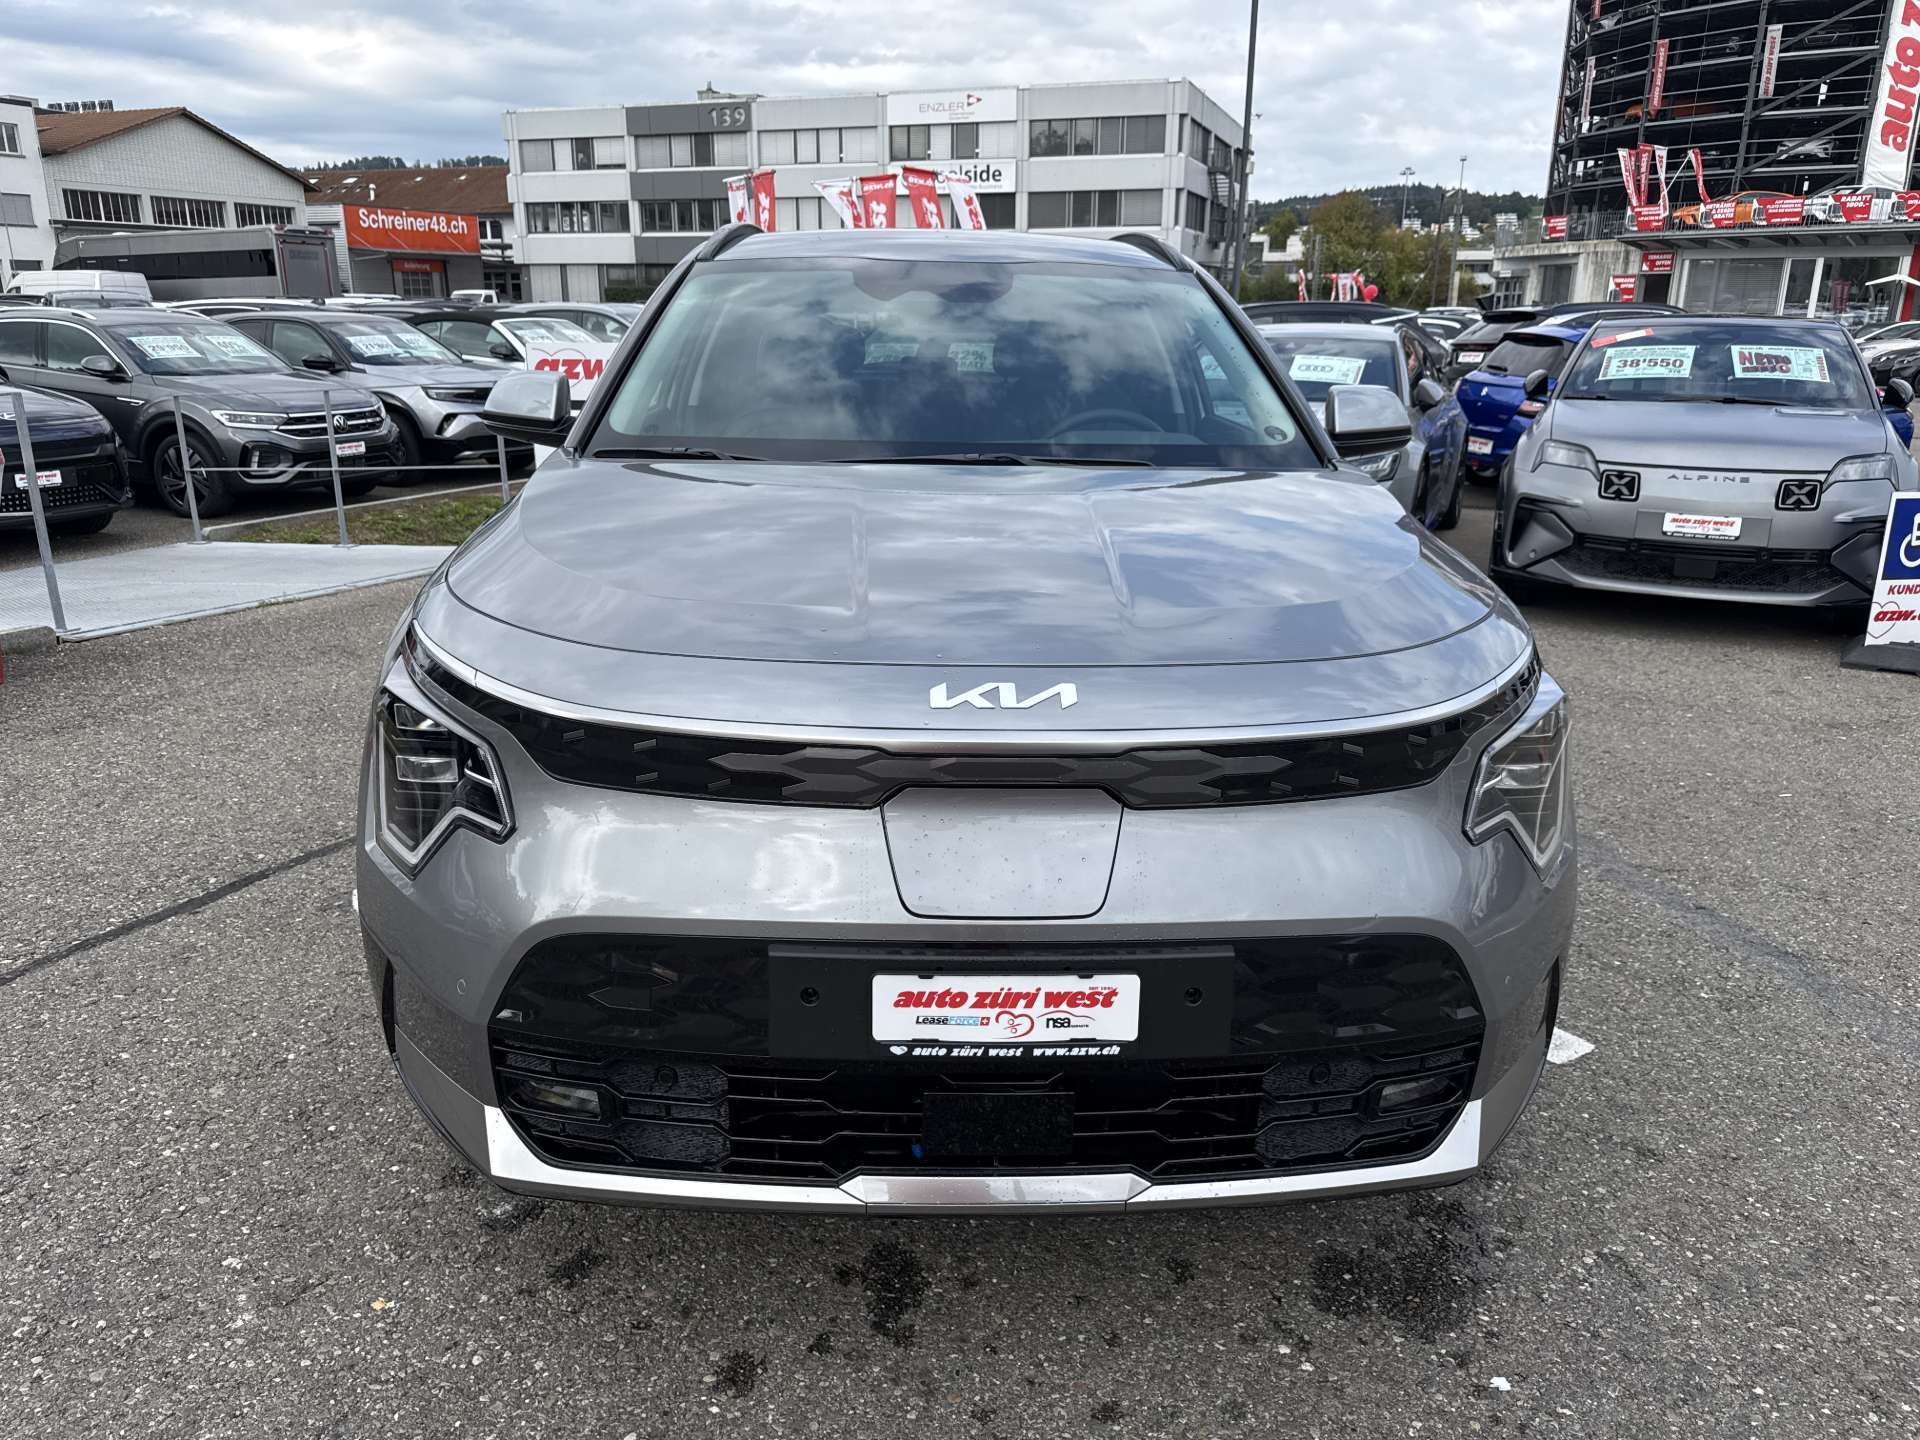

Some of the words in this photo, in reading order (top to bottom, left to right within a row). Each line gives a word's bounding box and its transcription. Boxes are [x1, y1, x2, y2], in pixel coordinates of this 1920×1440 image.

[919, 102, 965, 113] ENZLER
[709, 107, 746, 127] 139
[359, 208, 467, 234] Schreiner48.ch
[1615, 358, 1685, 369] 38'550
[1667, 473, 1750, 484] ALPINE
[1874, 609, 1920, 623] azw.
[893, 987, 969, 1009] auto
[969, 986, 1042, 1009] züri
[1042, 987, 1119, 1009] west
[915, 1015, 980, 1027] LeaseForce
[1045, 1017, 1071, 1028] nsa
[912, 1046, 947, 1056] auto
[951, 1045, 983, 1057] züri
[988, 1047, 1024, 1057] west
[1032, 1044, 1121, 1057] www.azw.ch
